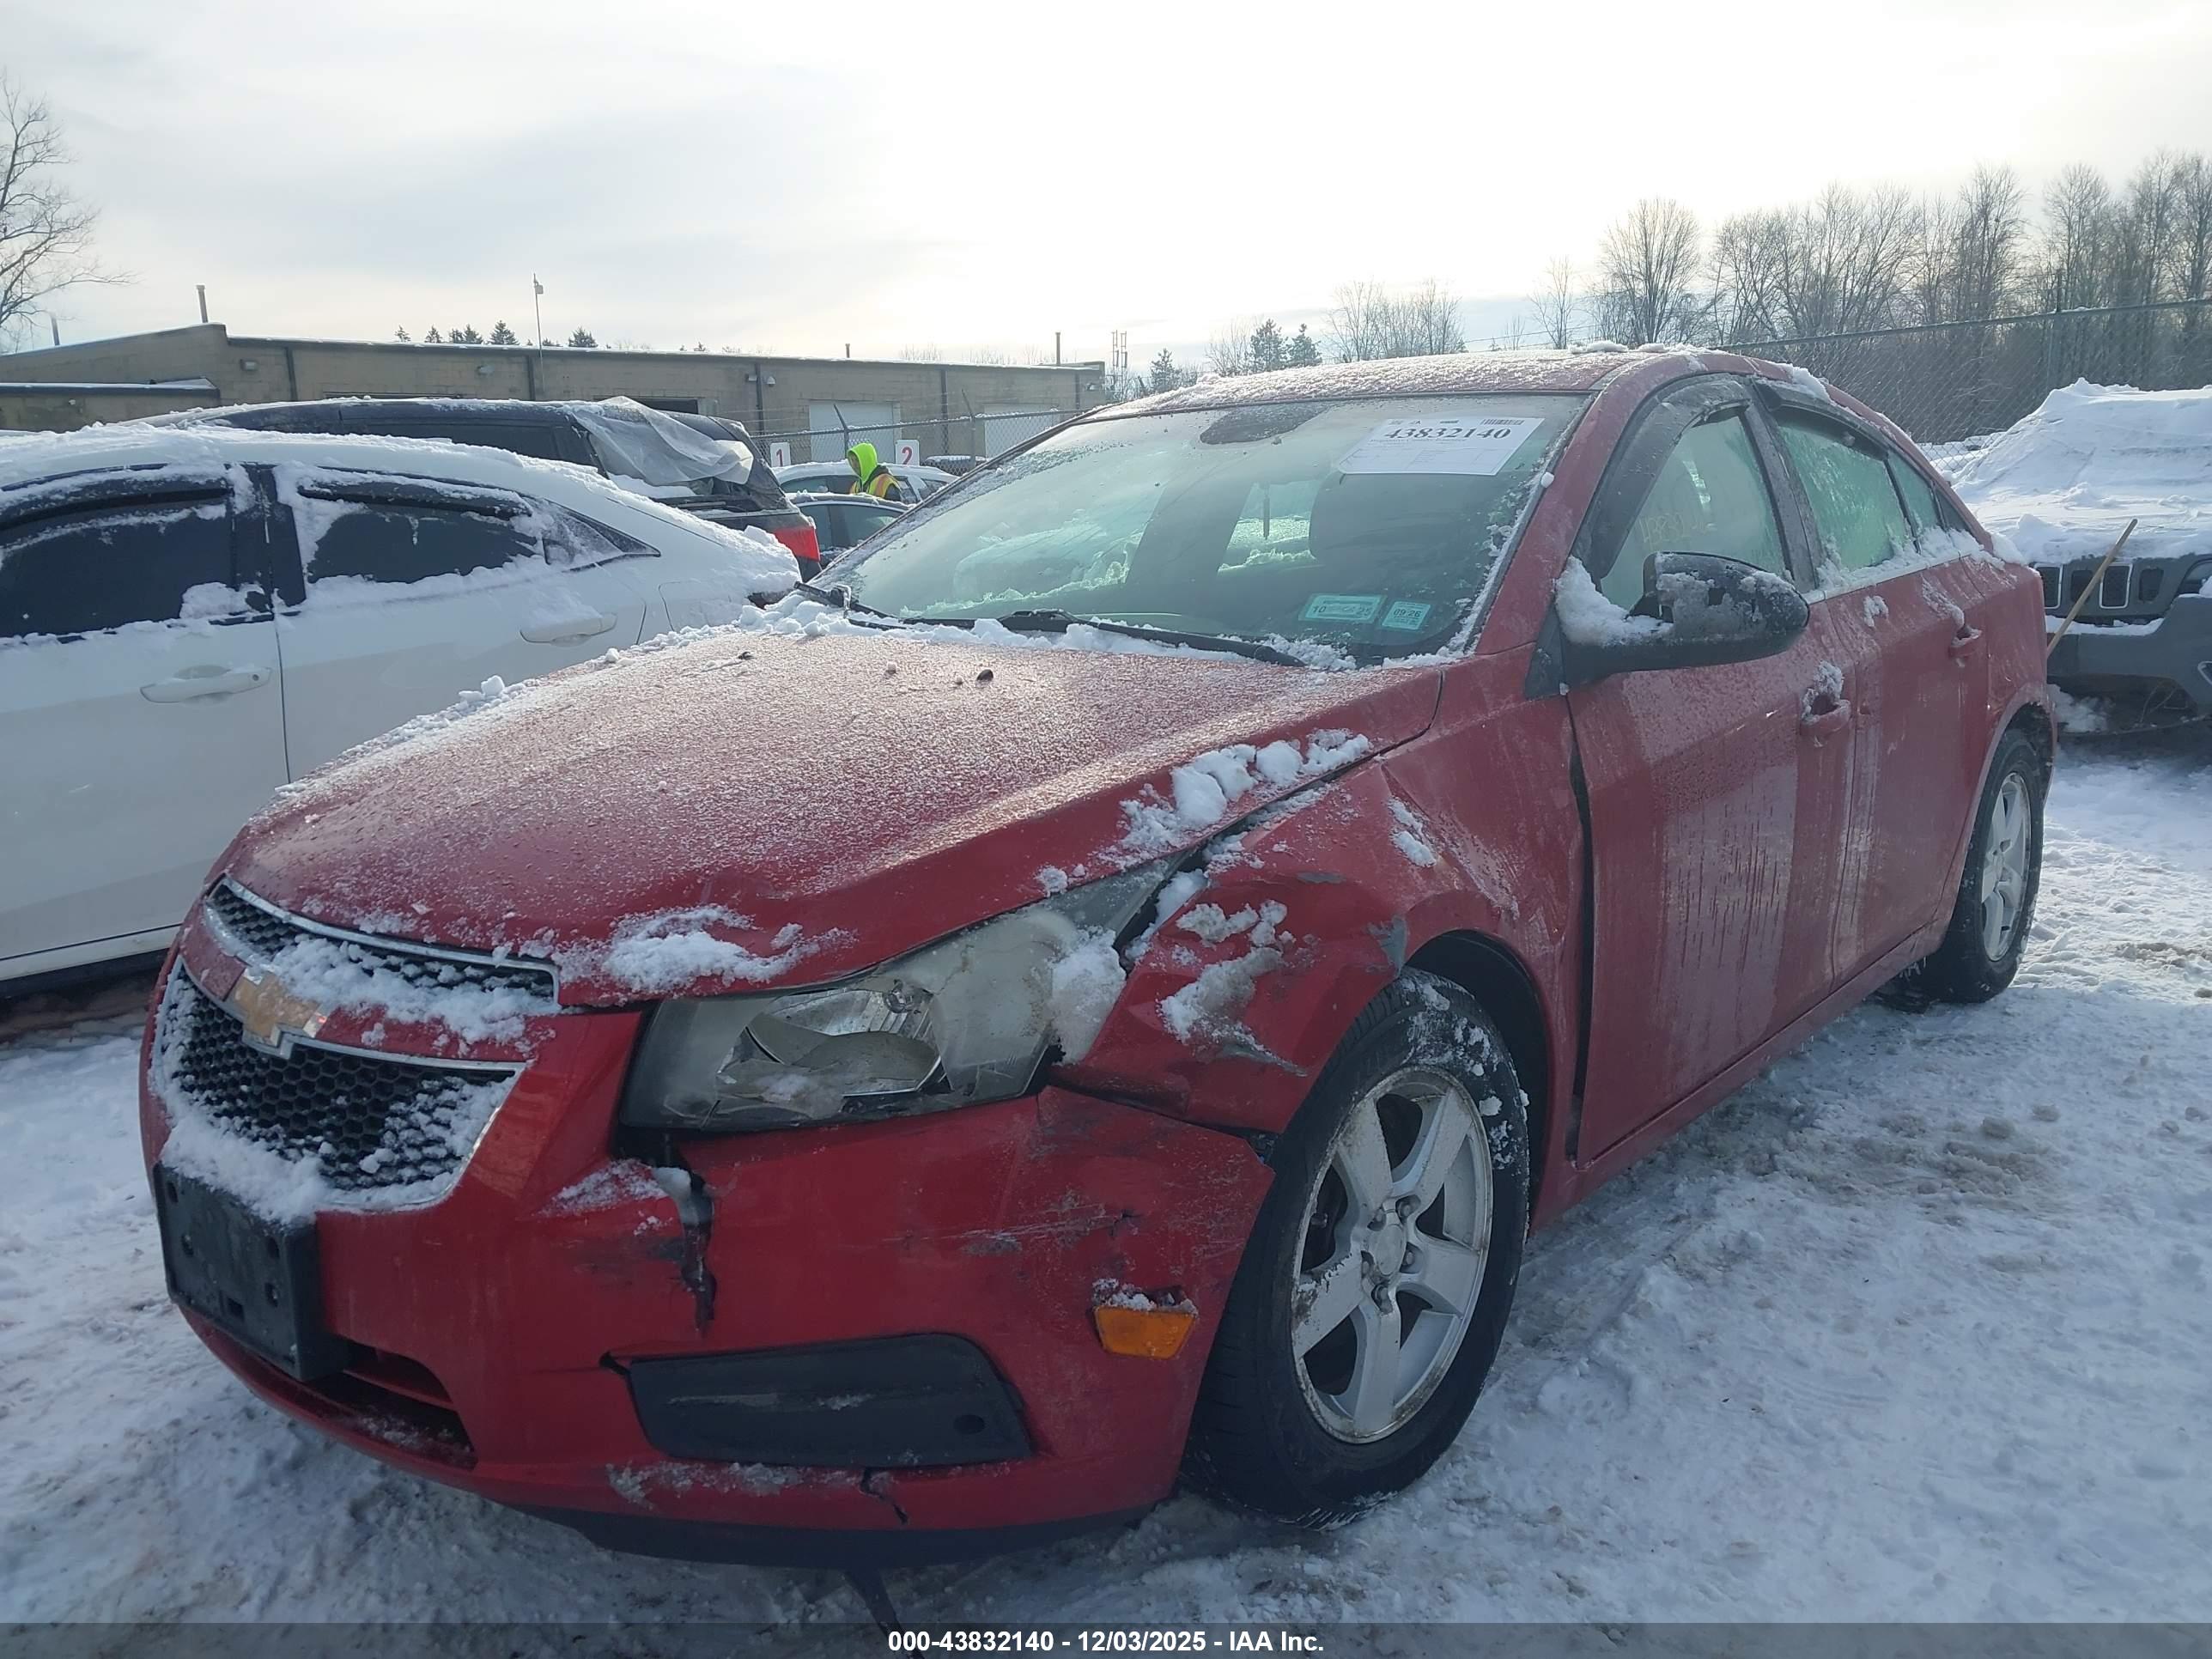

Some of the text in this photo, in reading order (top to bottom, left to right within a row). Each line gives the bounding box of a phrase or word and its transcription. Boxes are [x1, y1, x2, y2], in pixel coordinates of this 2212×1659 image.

[1383, 428, 1511, 439] 43832140
[775, 448, 783, 467] 1
[902, 446, 913, 465] 2
